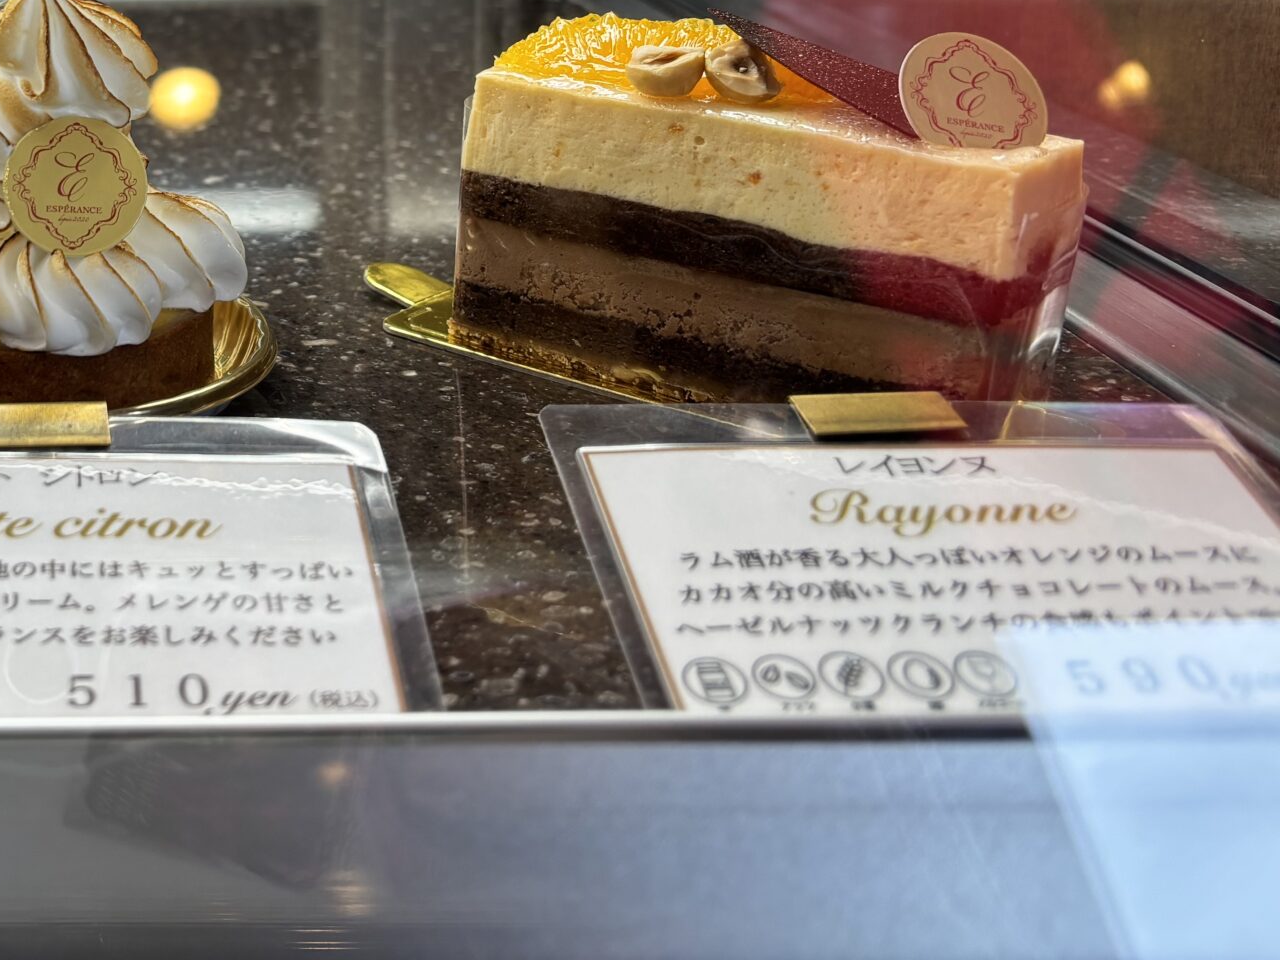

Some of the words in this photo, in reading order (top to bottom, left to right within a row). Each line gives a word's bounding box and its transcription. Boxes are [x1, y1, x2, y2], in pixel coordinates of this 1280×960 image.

[949, 66, 990, 118] E
[946, 116, 1005, 133] ESPÉRANCE
[55, 151, 95, 203] E
[45, 204, 103, 214] ESPÉRANCE
[42, 465, 158, 487] シトロン
[833, 455, 996, 476] レイヨンヌ
[53, 507, 223, 539] citron
[809, 488, 1078, 538] Rayonne
